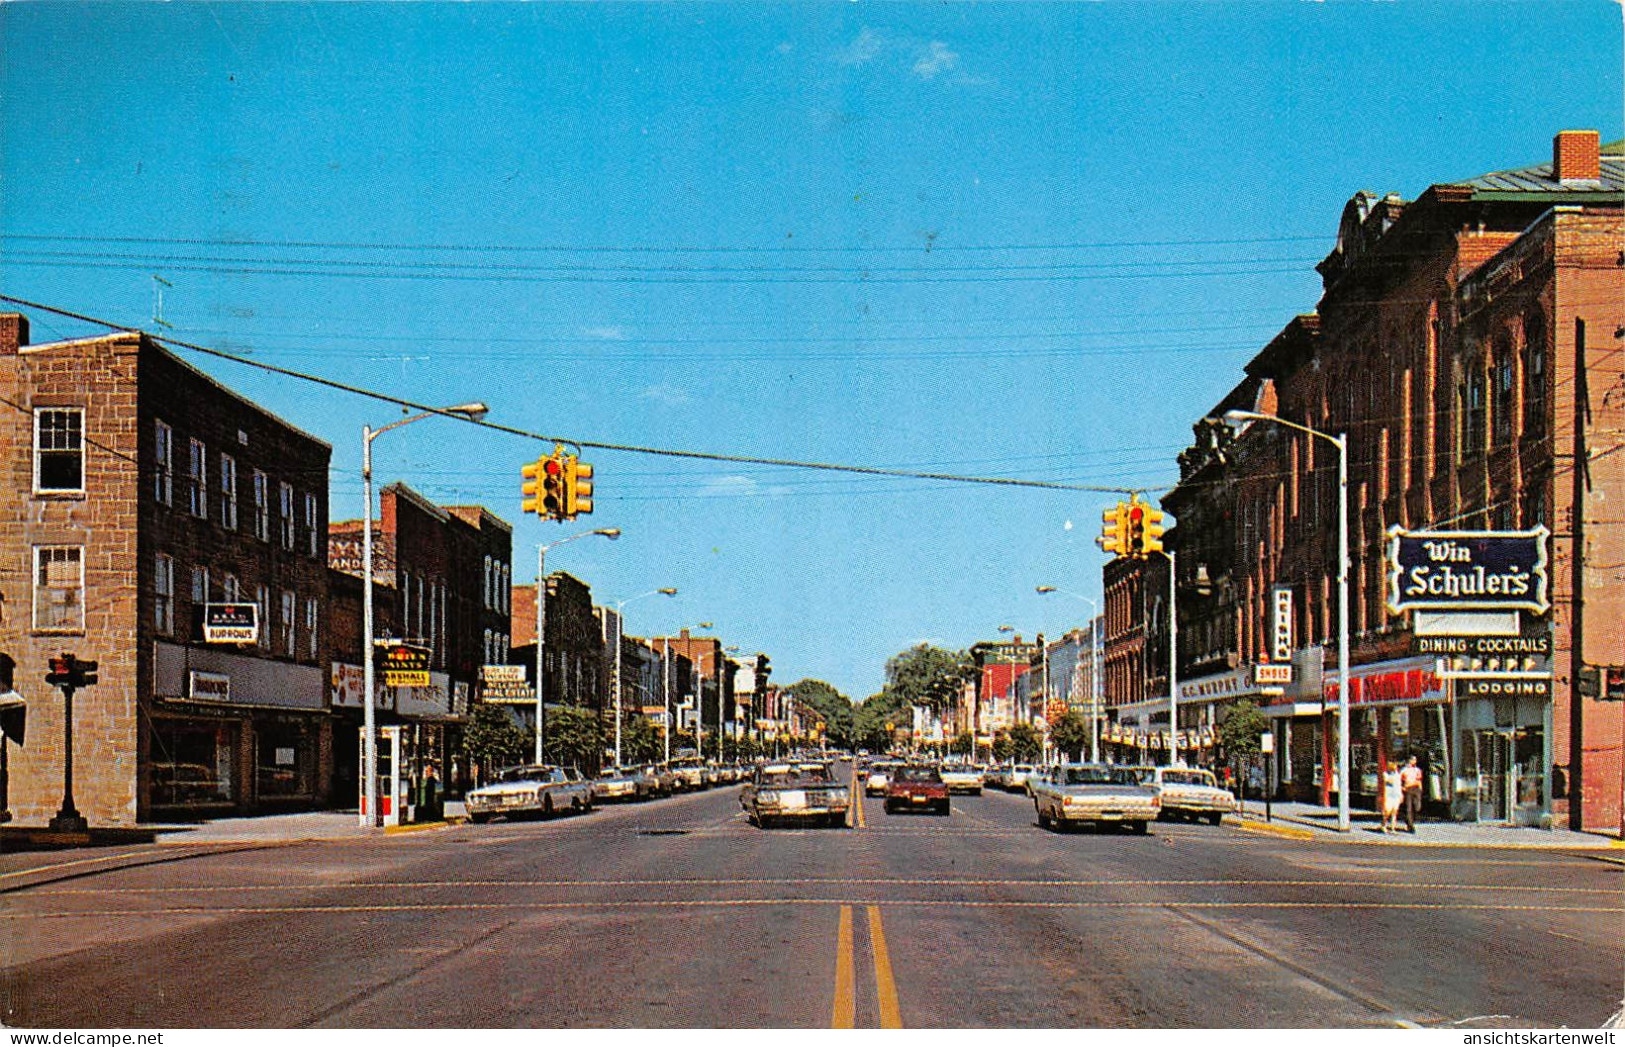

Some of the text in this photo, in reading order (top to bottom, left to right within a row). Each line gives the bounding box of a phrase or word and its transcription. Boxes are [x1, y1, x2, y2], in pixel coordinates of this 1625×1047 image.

[1424, 541, 1472, 562] Win
[1406, 566, 1530, 597] Schuler's
[1420, 639, 1547, 652] DINING COCKTAILS
[1198, 677, 1238, 696] MURPHY
[1469, 683, 1547, 694] LODGING
